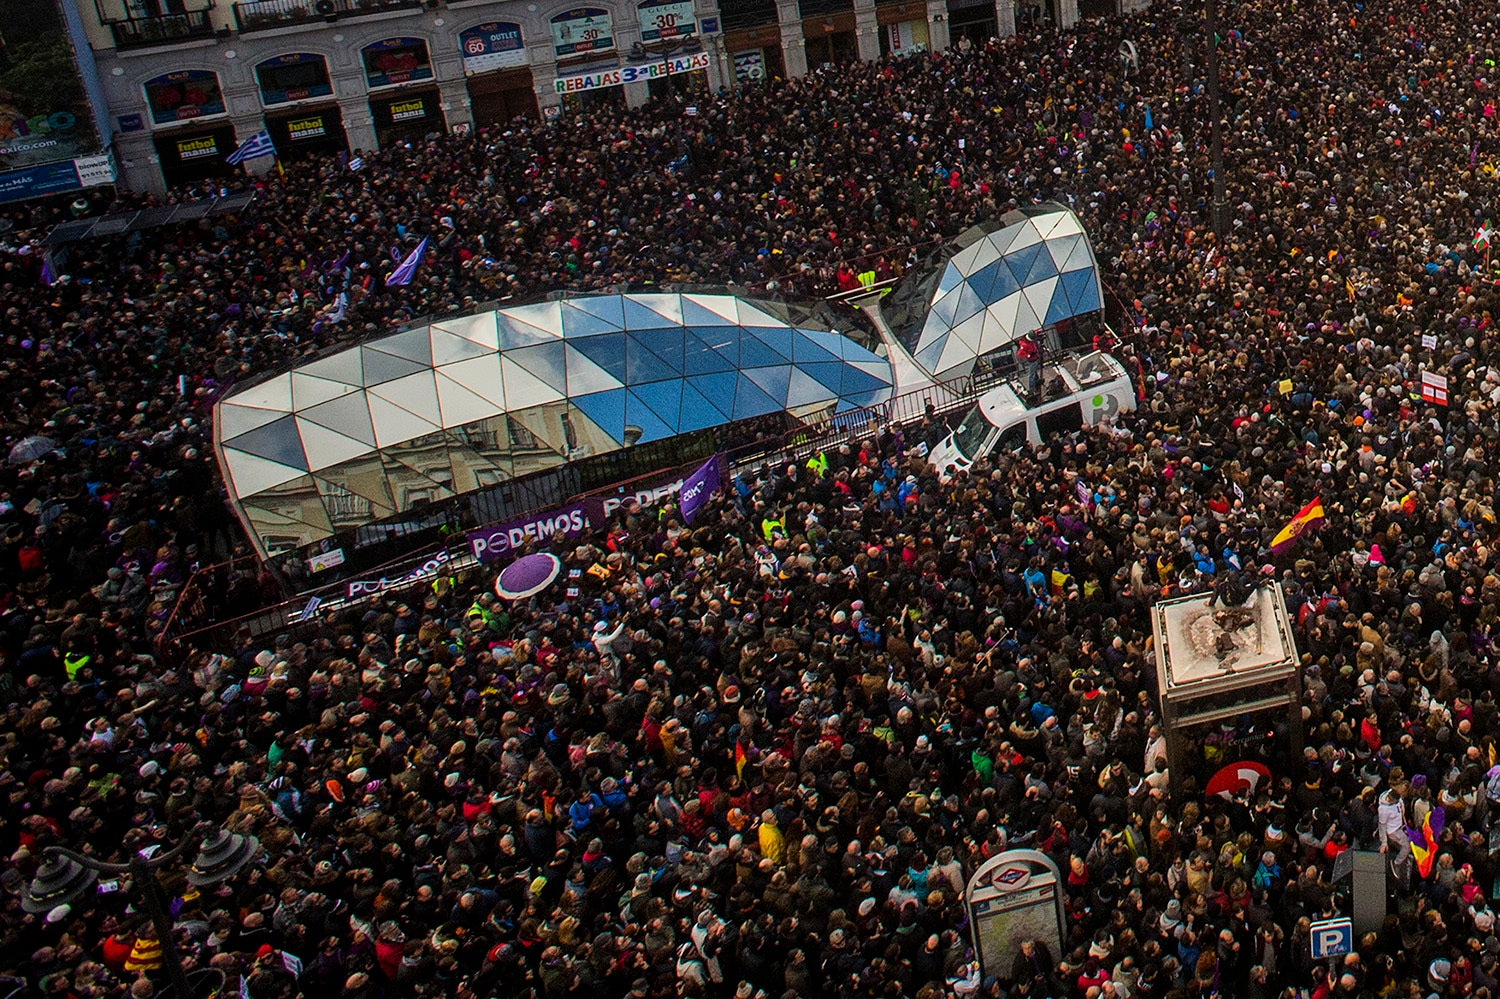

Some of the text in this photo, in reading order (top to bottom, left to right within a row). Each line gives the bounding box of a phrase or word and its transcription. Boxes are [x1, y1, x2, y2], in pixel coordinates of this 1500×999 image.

[647, 4, 686, 14] GUCCI
[490, 31, 518, 42] OUTLET
[556, 71, 622, 93] REBAJAS
[649, 54, 709, 78] REBAJAS
[390, 100, 424, 114] futbol
[392, 109, 425, 121] mania
[288, 119, 323, 133] futbol
[290, 126, 326, 140] mania
[0, 139, 58, 155] exico.com
[177, 138, 216, 153] futbol
[180, 146, 218, 159] mania
[472, 508, 584, 559] PODEMOS
[1319, 930, 1344, 957] P
